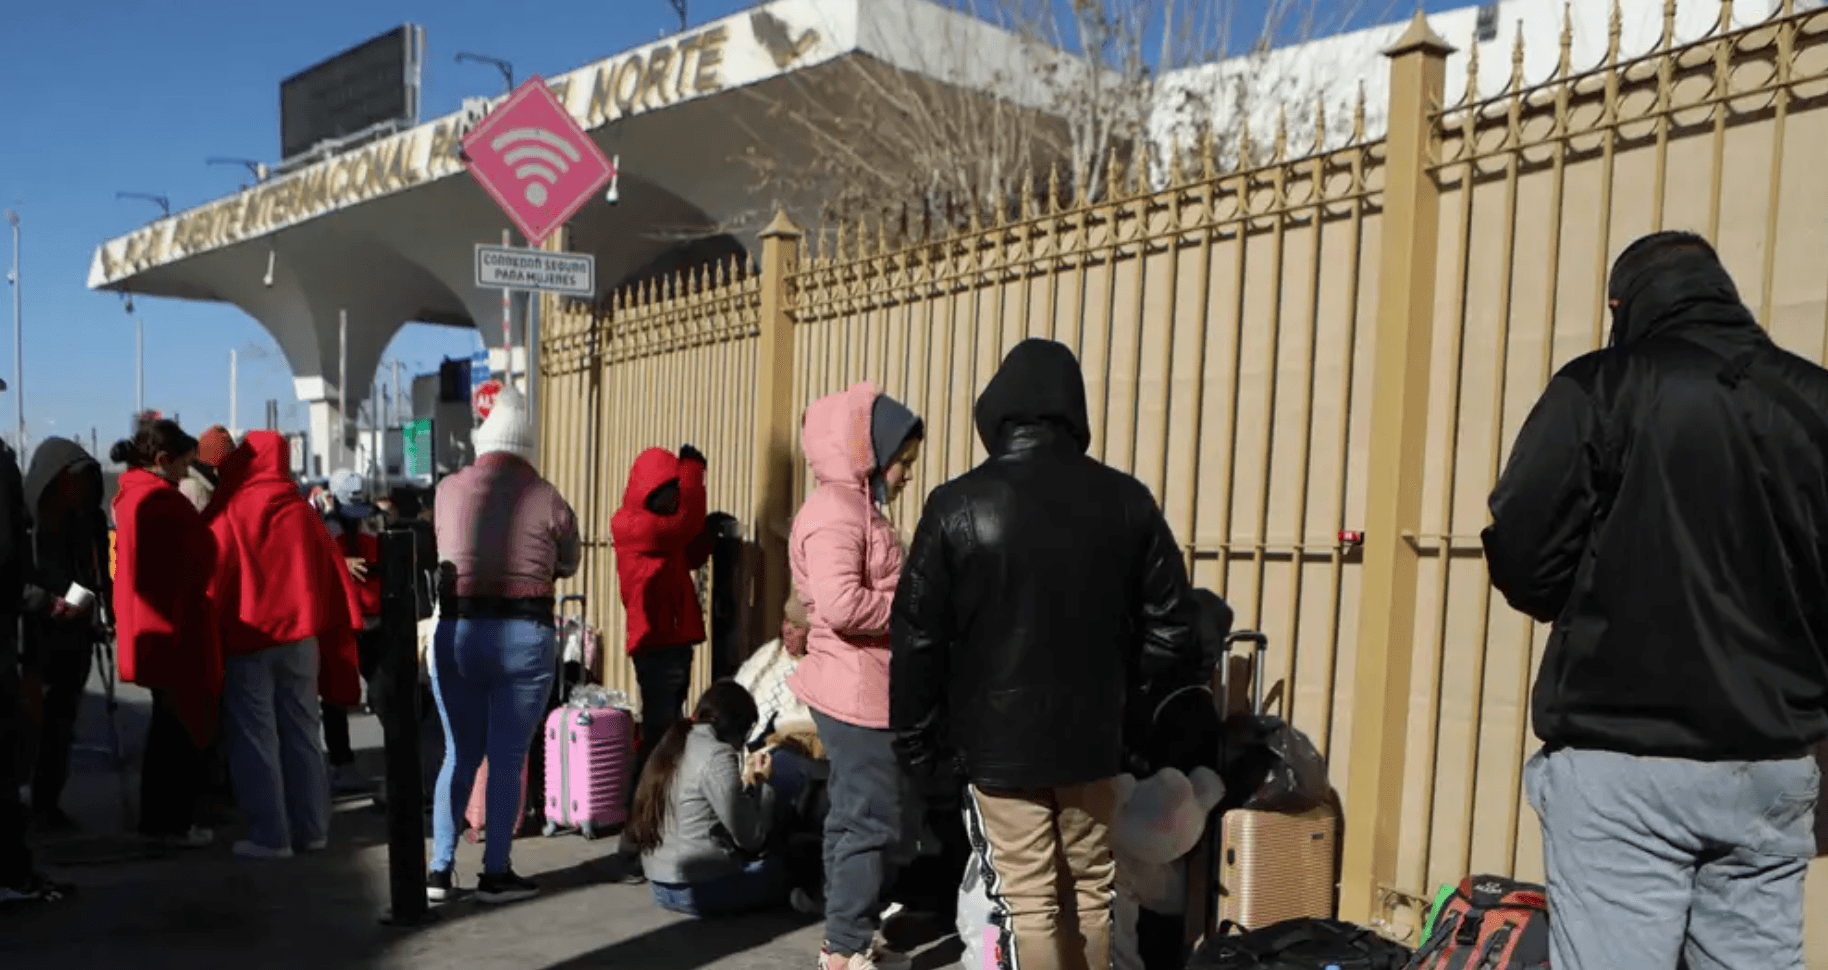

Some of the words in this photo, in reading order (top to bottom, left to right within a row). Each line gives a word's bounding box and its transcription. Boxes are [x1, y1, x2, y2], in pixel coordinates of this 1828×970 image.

[241, 132, 424, 232] INTERNACIONAL
[587, 25, 729, 122] NORTE
[494, 267, 524, 281] PARA
[525, 271, 577, 286] MUJERES
